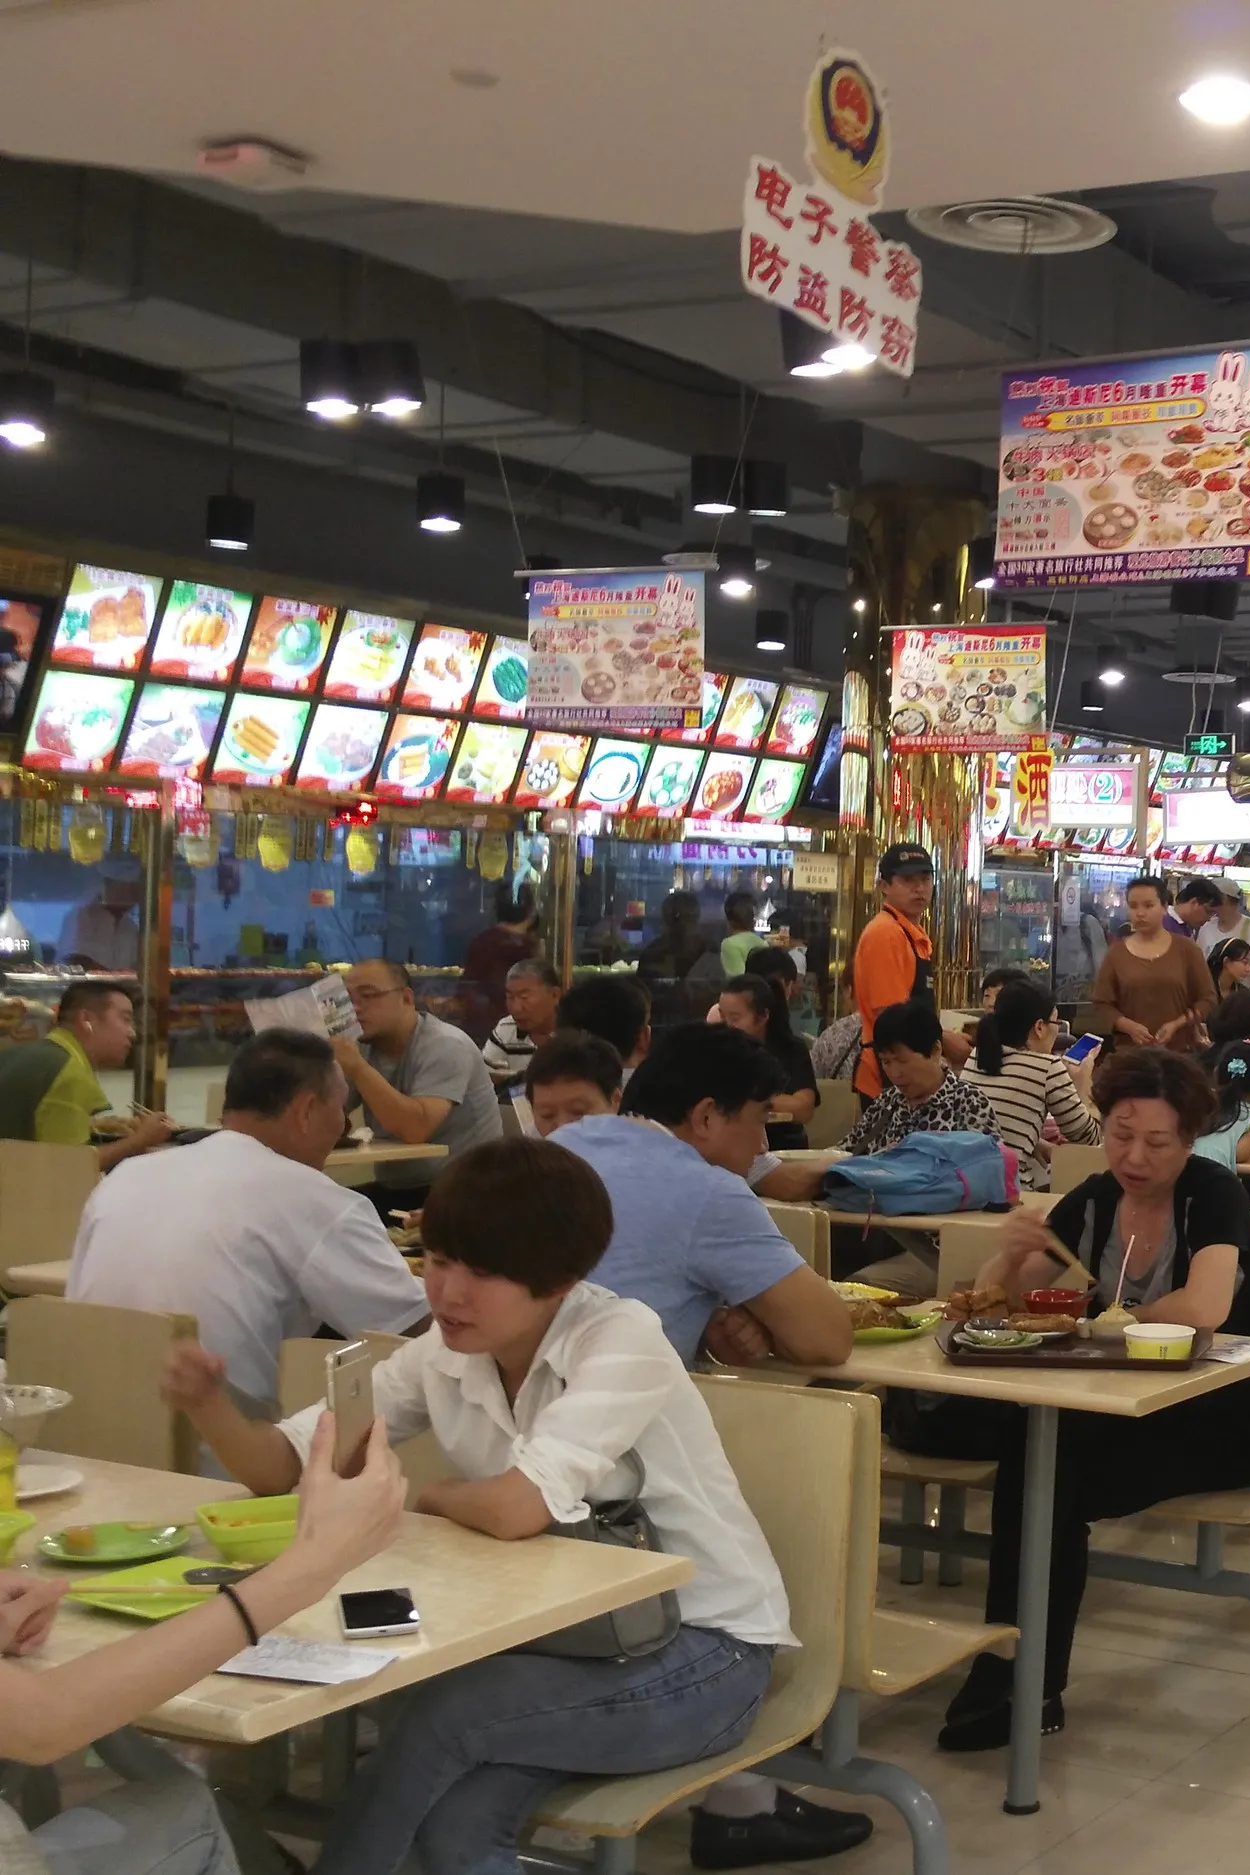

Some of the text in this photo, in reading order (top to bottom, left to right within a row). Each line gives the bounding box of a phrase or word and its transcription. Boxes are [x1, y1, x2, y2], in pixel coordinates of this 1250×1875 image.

[747, 231, 916, 369] 防盗防窃
[754, 163, 921, 303] 电子警察
[1016, 752, 1050, 828] 酒
